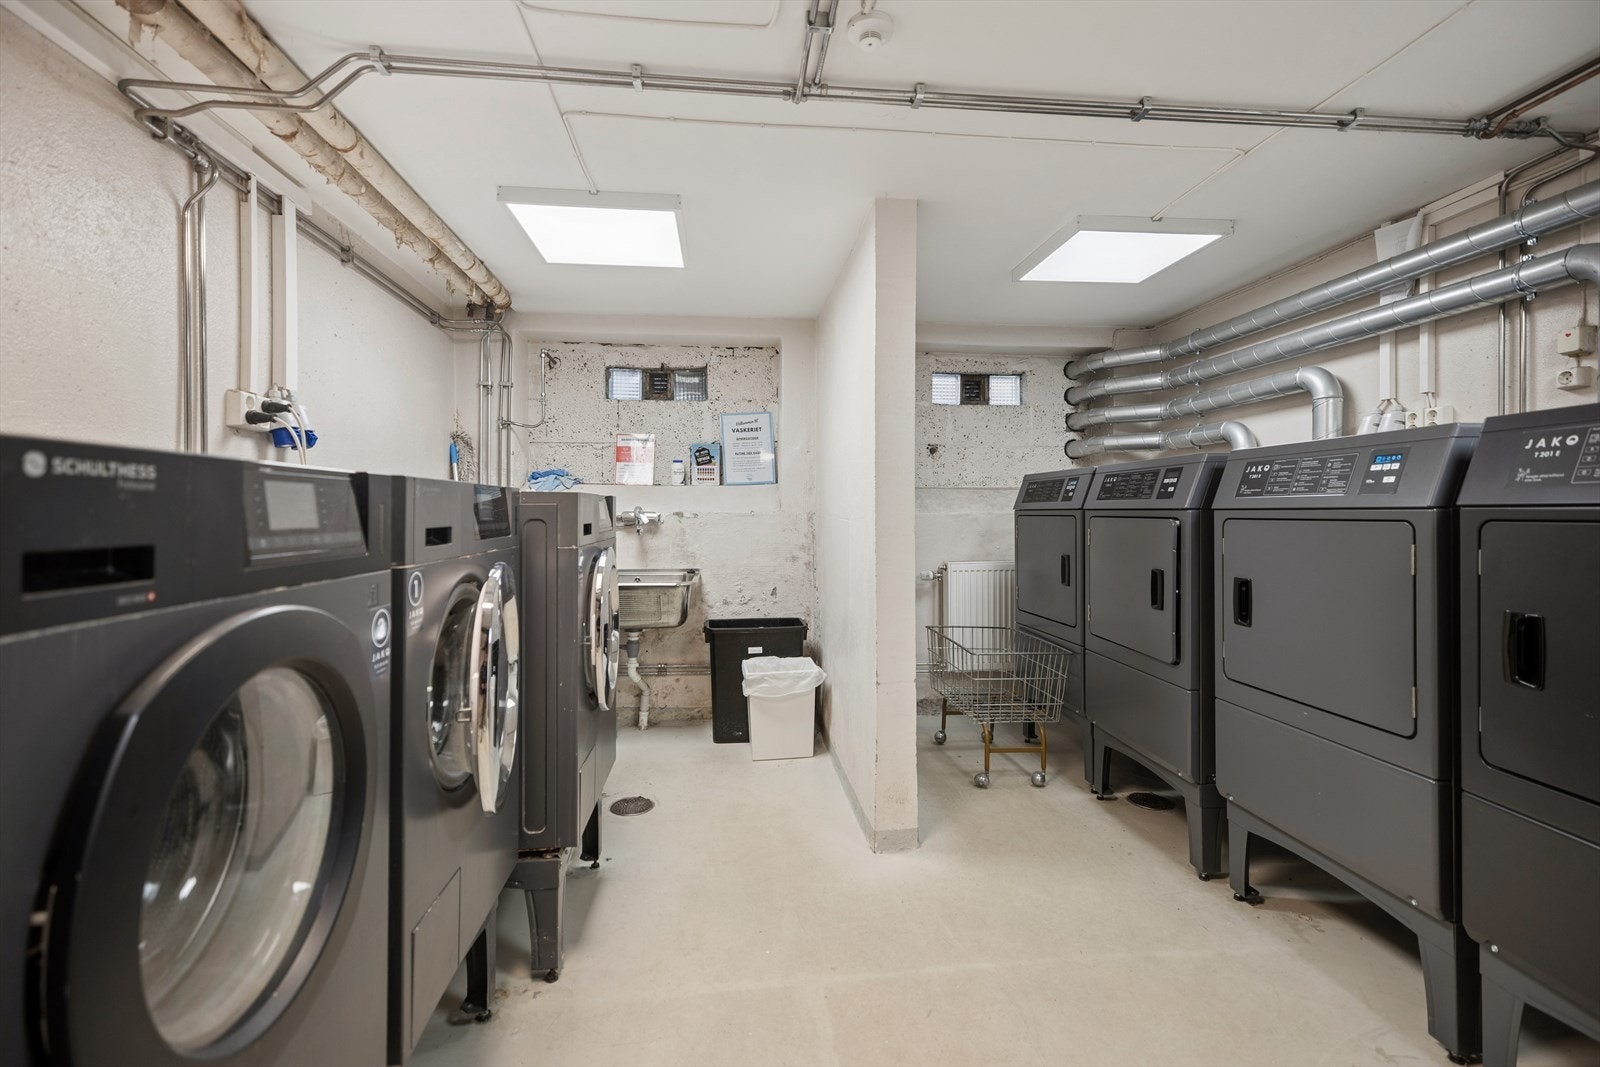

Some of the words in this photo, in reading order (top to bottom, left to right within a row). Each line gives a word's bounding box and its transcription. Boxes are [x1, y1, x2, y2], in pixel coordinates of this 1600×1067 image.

[1524, 434, 1579, 449] JAKO
[51, 457, 157, 480] SCHULTHESS
[1245, 464, 1270, 473] JAKO
[413, 579, 419, 598] 1
[372, 647, 391, 663] JAKO
